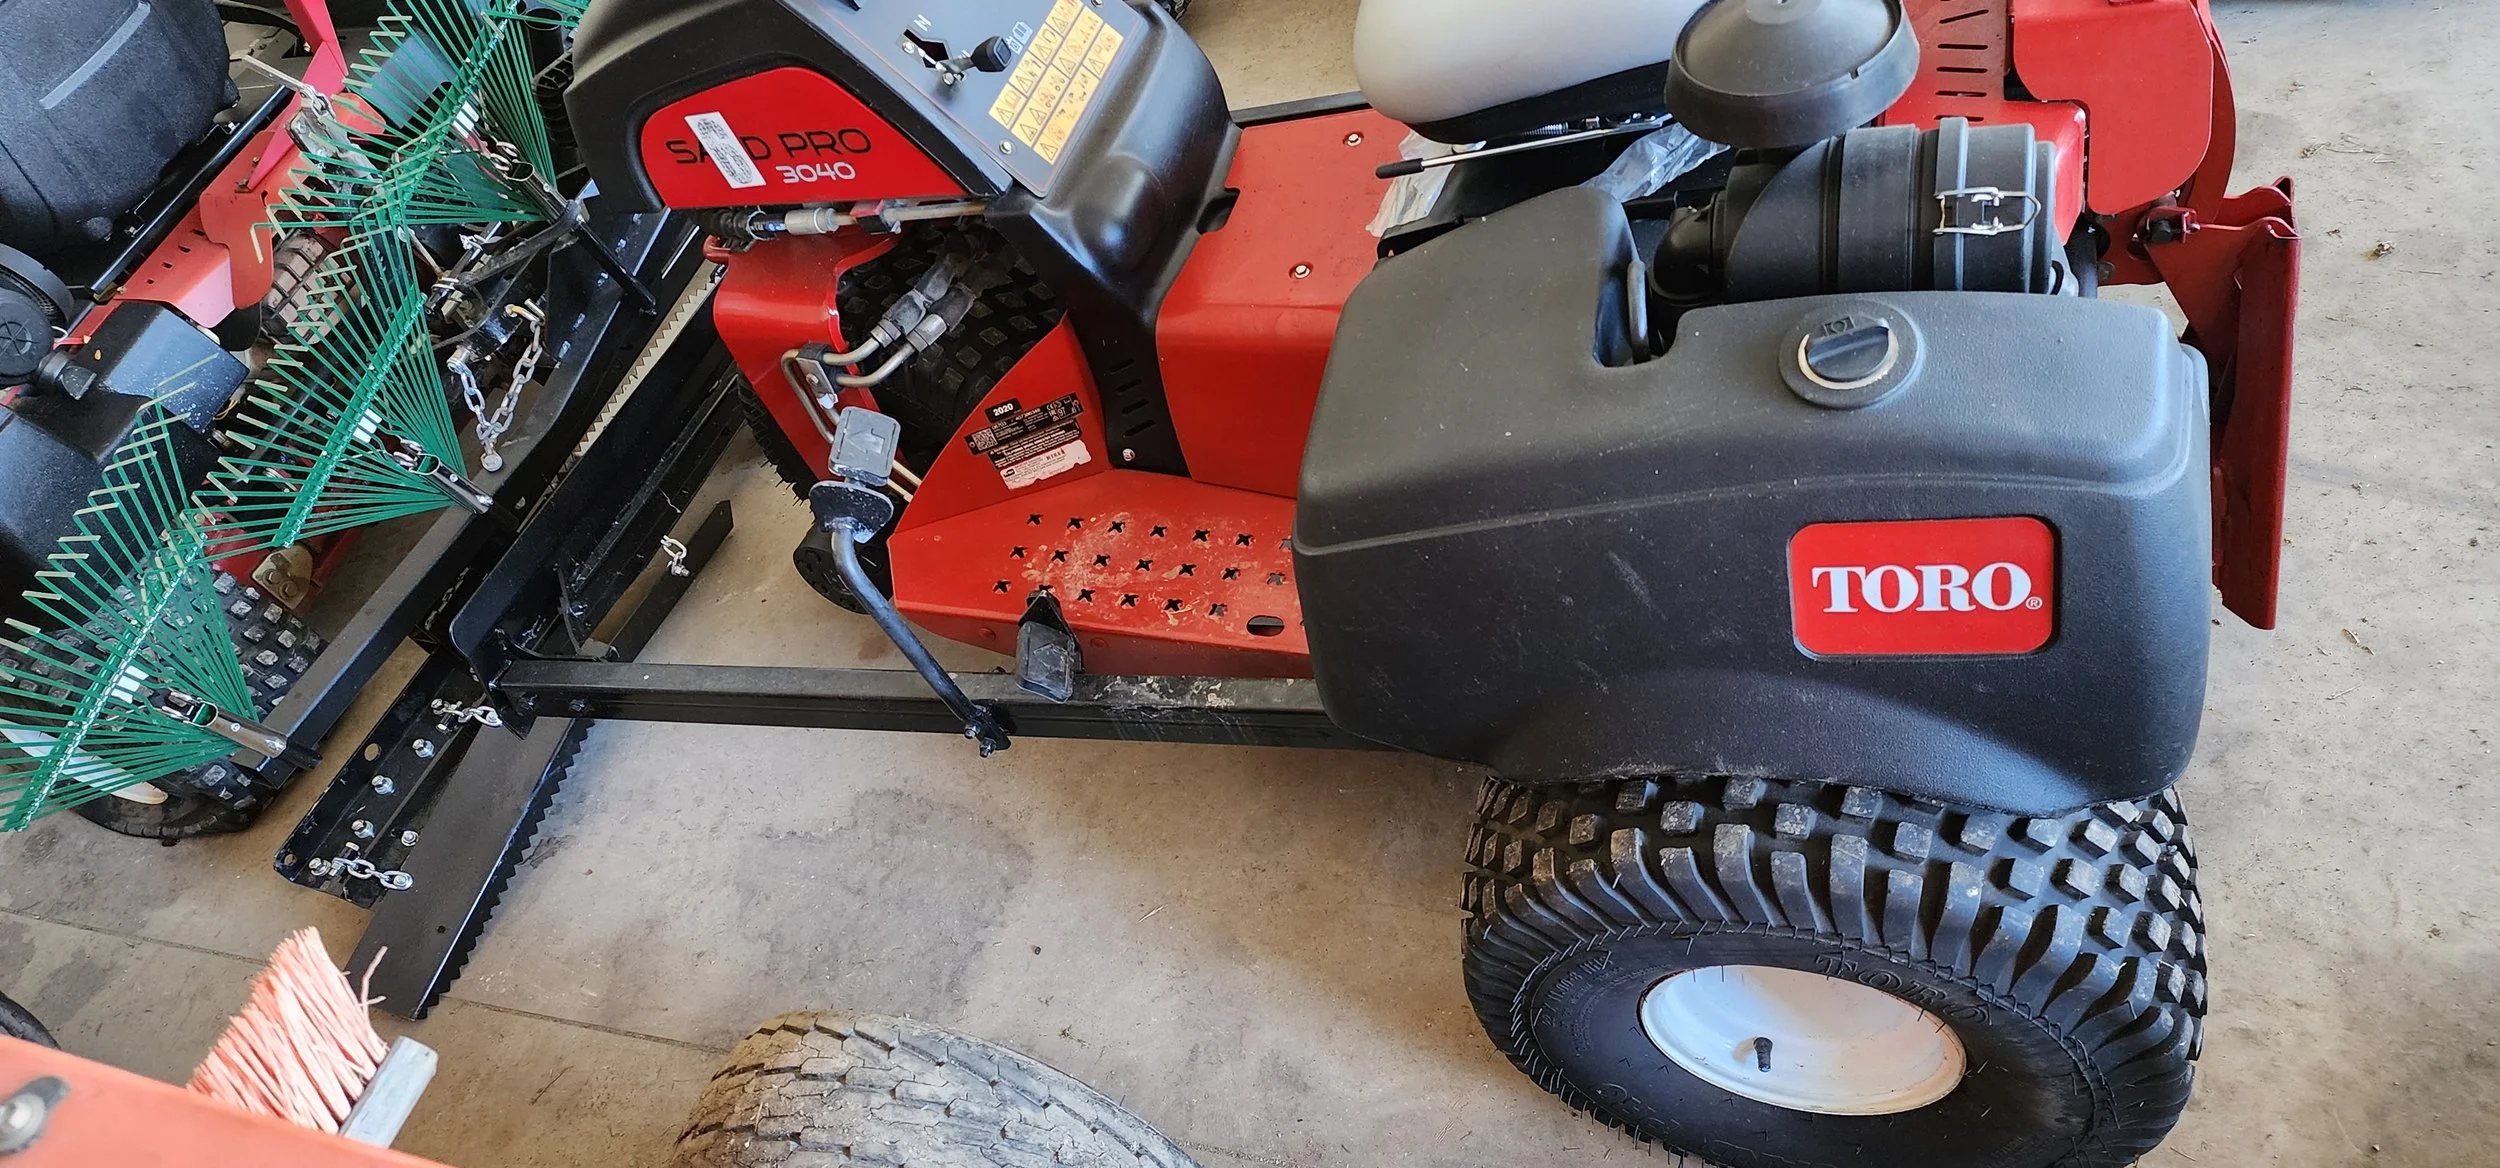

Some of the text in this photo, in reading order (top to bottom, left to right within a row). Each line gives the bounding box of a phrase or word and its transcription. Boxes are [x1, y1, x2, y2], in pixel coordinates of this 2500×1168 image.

[666, 128, 872, 164] SD PRO
[776, 161, 857, 184] 3040
[992, 403, 1014, 417] 2020
[1058, 407, 1067, 418] 97
[1813, 953, 1994, 1026] TORO
